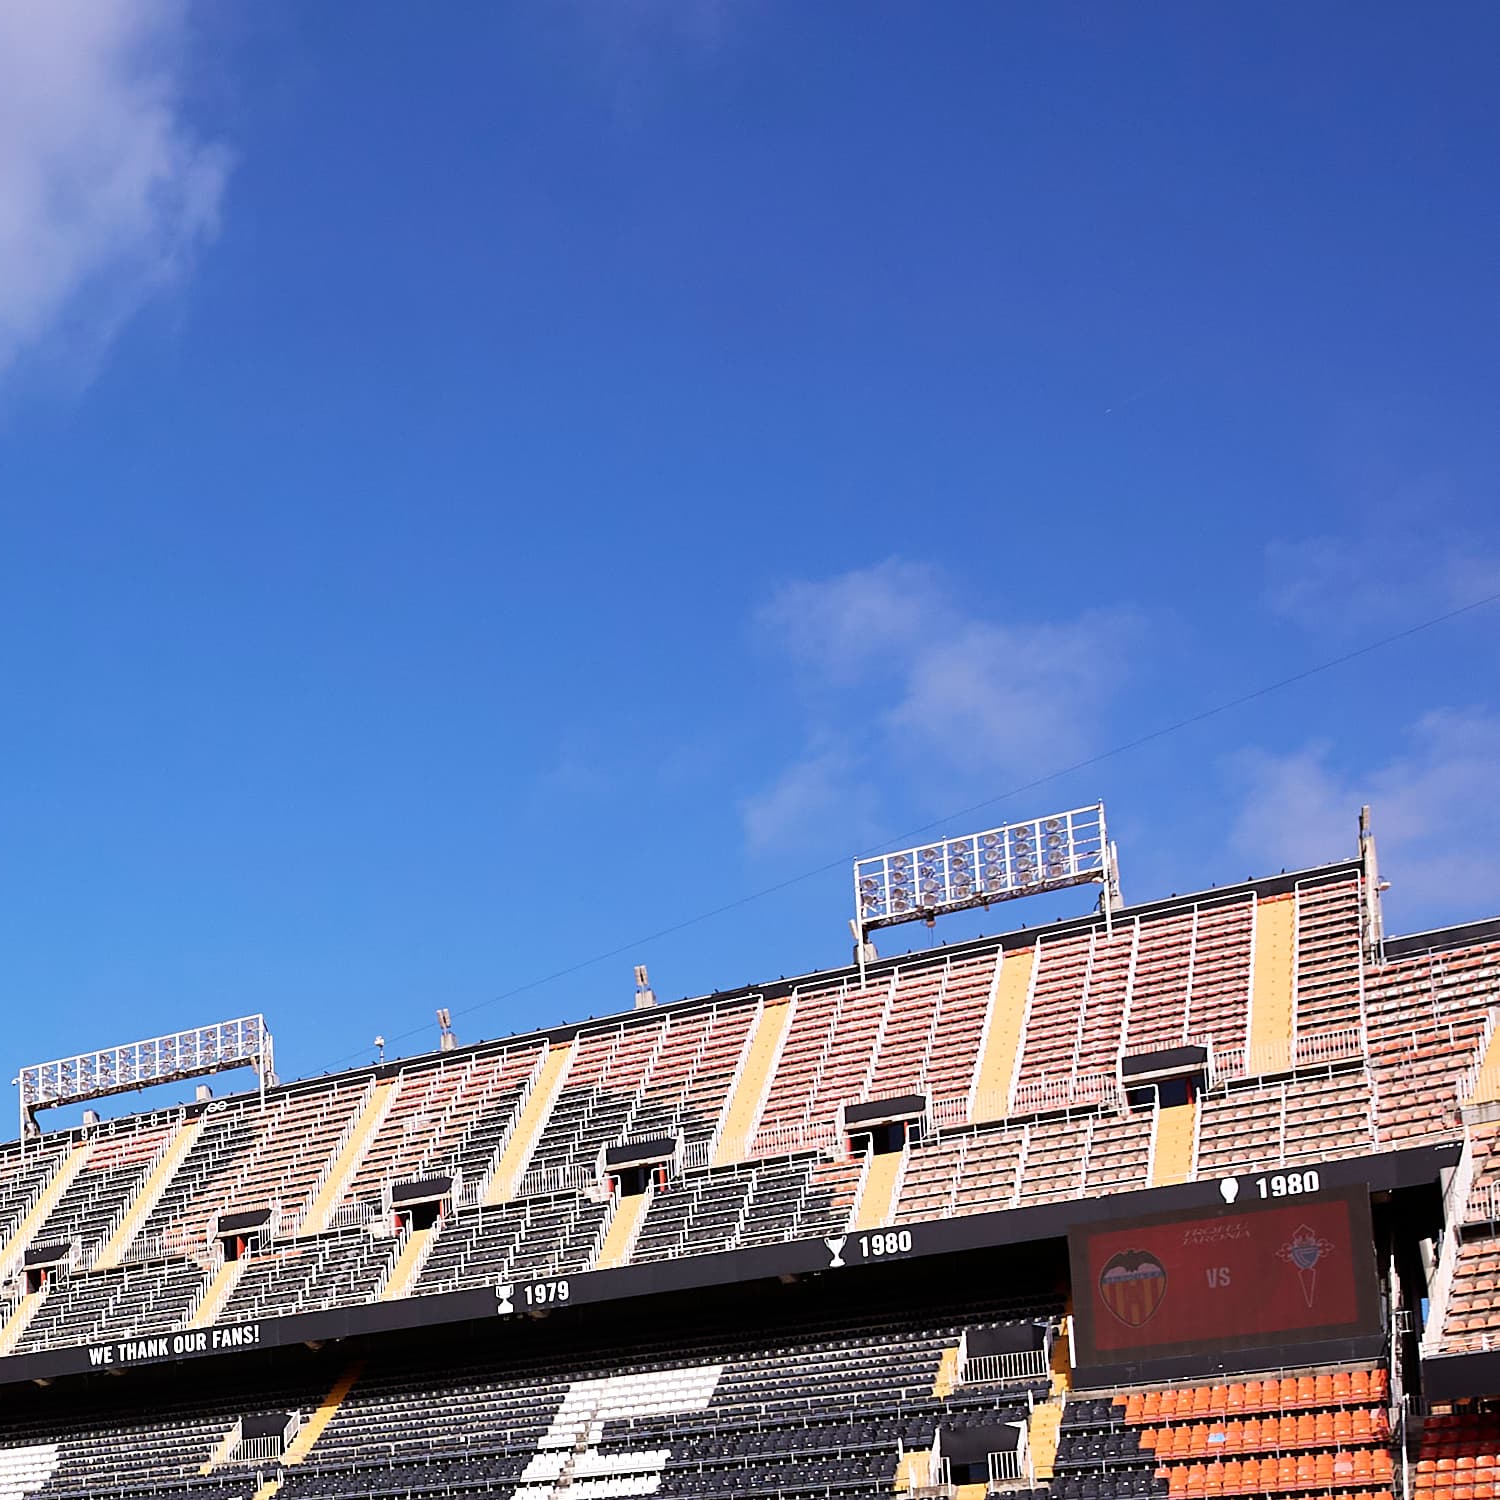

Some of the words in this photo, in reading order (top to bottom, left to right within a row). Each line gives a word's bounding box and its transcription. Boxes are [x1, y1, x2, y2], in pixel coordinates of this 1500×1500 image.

[1256, 1171, 1320, 1199] 1980
[859, 1230, 914, 1256] 1980
[1206, 1267, 1231, 1288] VS
[524, 1281, 570, 1305] 1979
[88, 1346, 114, 1366] WE
[116, 1338, 169, 1363] THANK
[172, 1330, 209, 1356] OUR
[211, 1325, 260, 1352] FANS!
